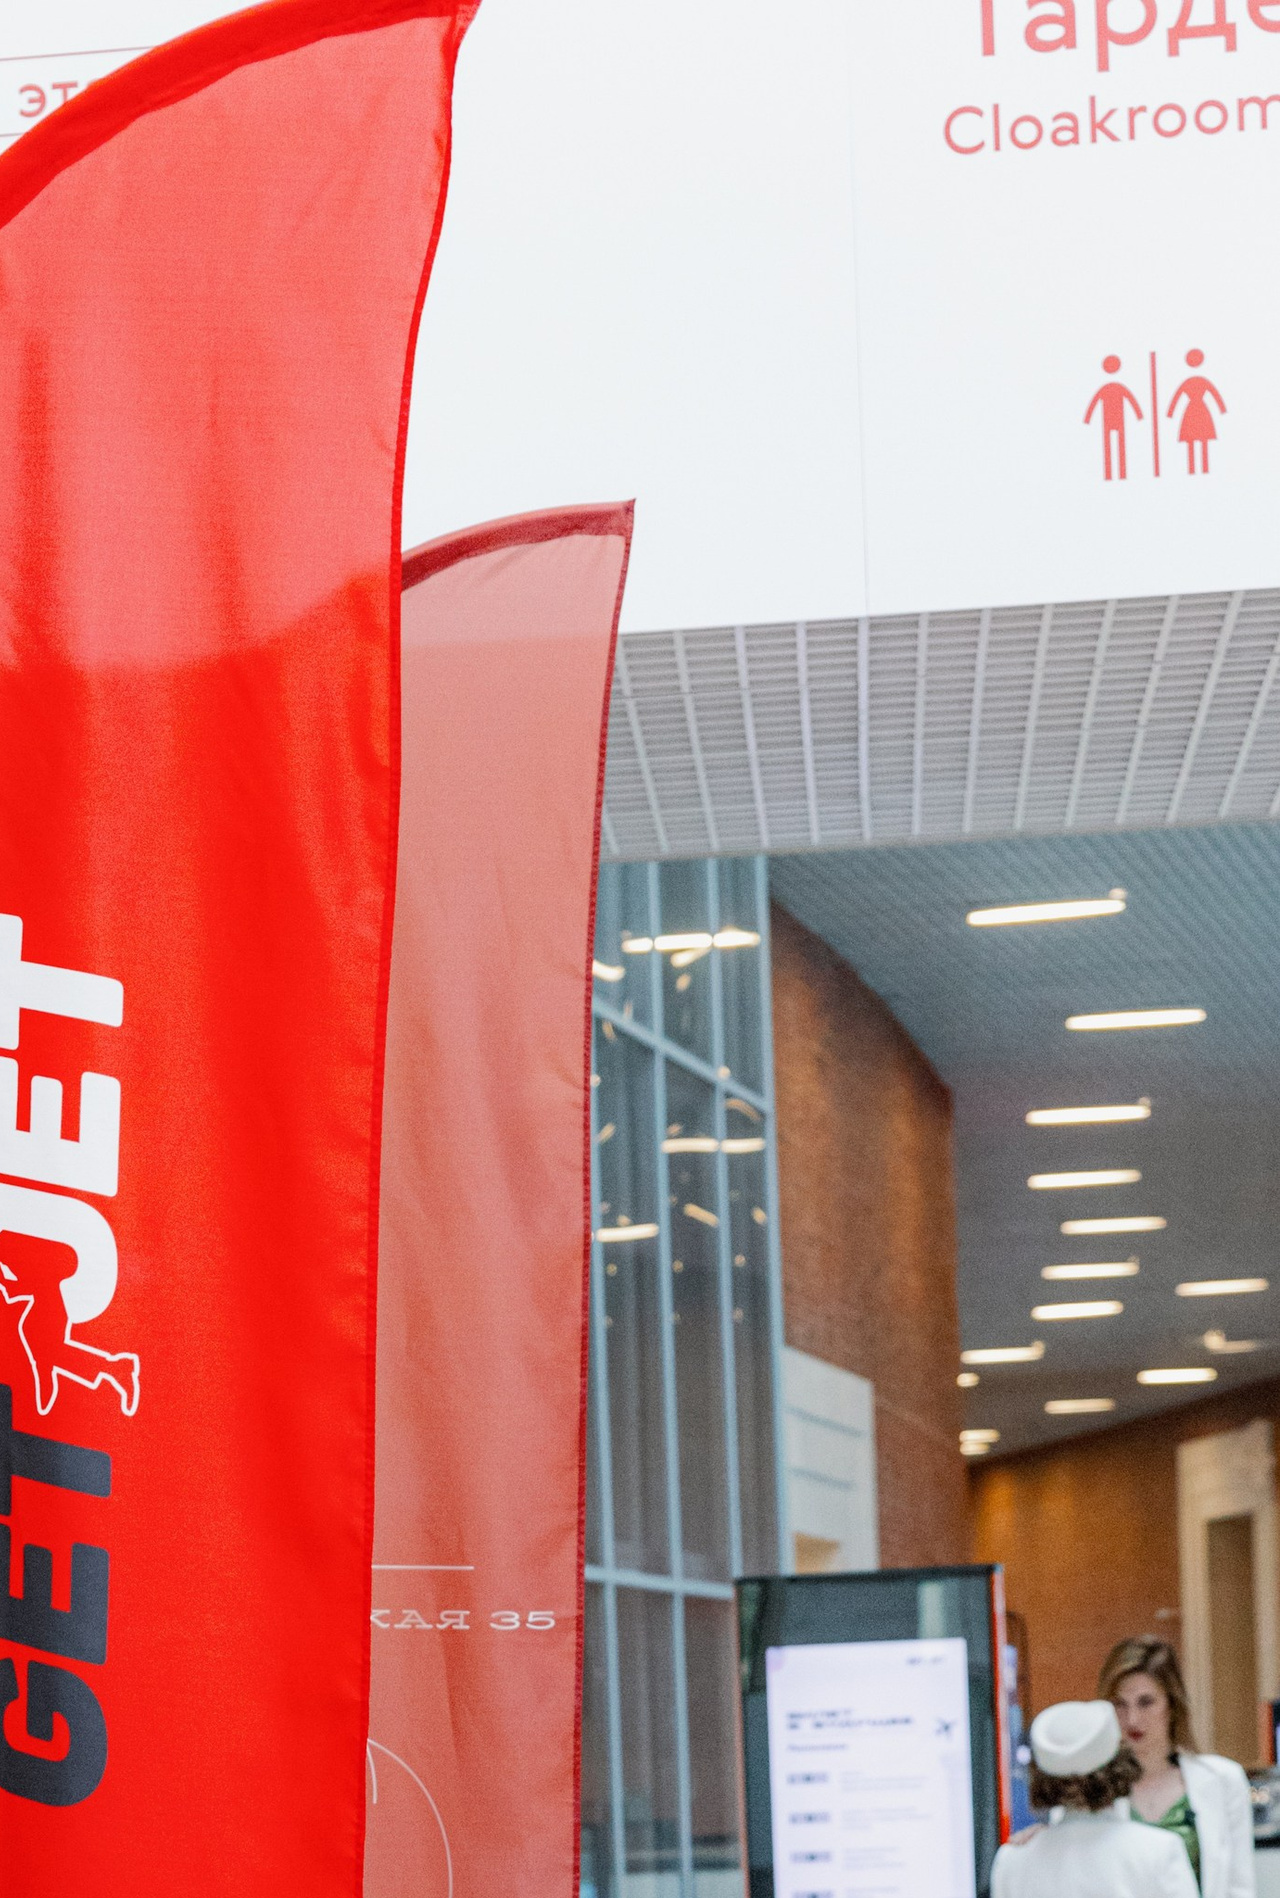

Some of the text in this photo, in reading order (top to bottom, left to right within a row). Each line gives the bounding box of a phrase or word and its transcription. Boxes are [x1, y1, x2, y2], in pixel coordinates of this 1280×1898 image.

[18, 80, 88, 118] эт
[943, 93, 1280, 156] Cloakroom
[489, 1610, 556, 1631] 35
